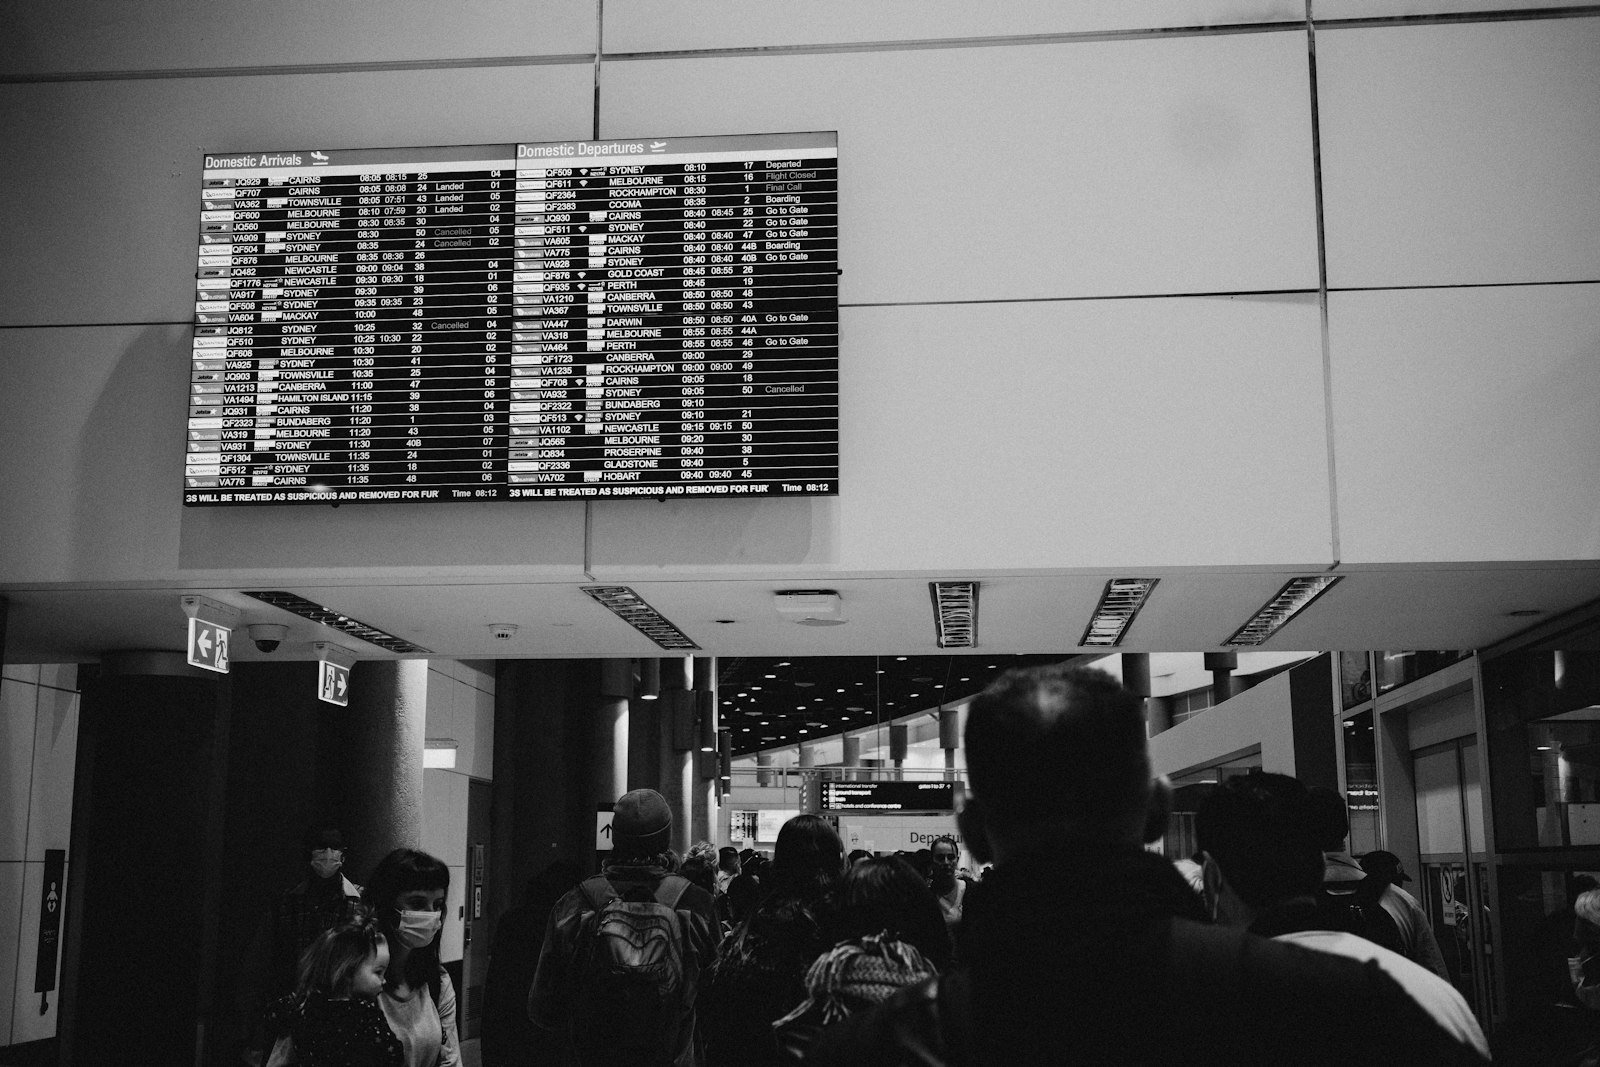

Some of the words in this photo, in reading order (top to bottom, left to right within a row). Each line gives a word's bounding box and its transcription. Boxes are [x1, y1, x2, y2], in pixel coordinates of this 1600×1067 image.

[518, 144, 574, 157] Domestic
[578, 141, 643, 156] Departures
[205, 155, 256, 168] Domestic
[259, 154, 301, 166] Arrivals
[545, 168, 572, 176] QF509
[609, 165, 644, 174] SYDNEY
[766, 159, 801, 170] Departed
[289, 175, 320, 184] CAIRNS
[609, 176, 663, 185] MELBOURNE
[766, 172, 786, 180] Flight
[234, 189, 261, 197] QF707
[288, 187, 320, 195] CAIRNS
[436, 182, 463, 190] Landed
[609, 187, 675, 196] ROCKHAMPTON
[287, 197, 341, 206] TOWNSVILLE
[609, 200, 641, 208] COOMA
[766, 194, 800, 204] Boarding
[287, 209, 340, 217] MELBOURNE
[435, 205, 463, 213] Landed
[609, 211, 640, 219] CAIRNS
[766, 206, 777, 214] Go
[789, 205, 808, 213] Gate
[287, 220, 339, 229] MELBOURNE
[544, 225, 569, 233] QF511
[608, 223, 643, 231] SYDNEY
[766, 218, 777, 226] Go
[789, 217, 808, 225] Gate
[285, 232, 320, 240] SYDNEY
[608, 234, 644, 243] MACKAY
[766, 229, 777, 237] Go
[284, 243, 320, 251] SYDNEY
[543, 248, 570, 256] VA775
[608, 246, 640, 254] CAIRNS
[765, 241, 800, 250] Boarding
[285, 254, 338, 263] MELBOURNE
[608, 257, 643, 266] SYDNEY
[765, 253, 777, 261] Go
[789, 252, 808, 260] Gate
[285, 265, 336, 274] NEWCASTLE
[608, 269, 632, 277] GOLD
[634, 268, 664, 277] COAST
[229, 279, 261, 287] QF1776
[284, 277, 336, 285] NEWCASTLE
[608, 281, 636, 289] PERTH
[282, 289, 318, 297] SYDNEY
[542, 294, 573, 303] VA1210
[607, 292, 655, 301] CANBERRA
[283, 300, 318, 308] SYDNEY
[607, 303, 662, 312] TOWNSVILLE
[281, 312, 318, 320] MACKAY
[607, 318, 642, 326] DARWIN
[789, 313, 808, 321] Gate
[282, 324, 316, 333] SYDNEY
[431, 321, 468, 329] Cancelled
[607, 329, 661, 338] MELBOURNE
[225, 337, 253, 346] QF510
[281, 336, 316, 344] SYDNEY
[606, 341, 635, 349] PERTH
[789, 337, 808, 345] Gate
[280, 347, 334, 356] MELBOURNE
[541, 355, 572, 363] QF1723
[606, 353, 654, 361] CANBERRA
[280, 359, 315, 367] SYDNEY
[540, 366, 572, 374] VA1235
[606, 364, 673, 373] ROCKHAMPTON
[278, 371, 333, 379] TOWNSVILLE
[223, 384, 254, 392] VA1213
[277, 382, 326, 390] CANBERRA
[605, 388, 641, 396] SYDNEY
[277, 394, 318, 402] HAMILTON
[539, 402, 571, 410] QF2322
[605, 400, 660, 408] BUNDABERG
[276, 406, 310, 414] CAIRNS
[605, 412, 641, 420] SYDNEY
[221, 419, 253, 427] QF2323
[277, 417, 330, 426] BUNDABERG
[605, 424, 658, 432] NEWCASTLE
[275, 429, 330, 437] MELBOURNE
[604, 435, 659, 444] MELBOURNE
[275, 441, 311, 449] SYDNEY
[604, 447, 661, 456] PROSERPINE
[219, 454, 251, 462] QF1304
[275, 453, 330, 461] TOWNSVILLE
[604, 459, 657, 468] GLADSTONE
[218, 466, 246, 474] QF512
[274, 465, 309, 473] SYDNEY
[538, 473, 564, 481] VA702
[604, 472, 640, 480] HOBART
[521, 488, 543, 496] WILL
[544, 488, 556, 496] BE
[557, 487, 597, 496] TREATED
[598, 487, 610, 495] AS
[612, 486, 664, 495] SUSPICIOUS
[665, 486, 684, 494] AND
[685, 485, 728, 493] REMOVED
[729, 484, 748, 492] FOR
[749, 484, 768, 492] FUR
[781, 483, 802, 491] Time
[806, 483, 828, 491] 08:12
[220, 493, 232, 501] BE
[233, 493, 272, 501] TREATED
[287, 491, 337, 500] SUSPICIOUS
[338, 491, 357, 499] AND
[358, 490, 400, 499] REMOVED
[401, 490, 419, 498] FOR
[420, 490, 439, 498] FUR
[451, 489, 471, 497] Time
